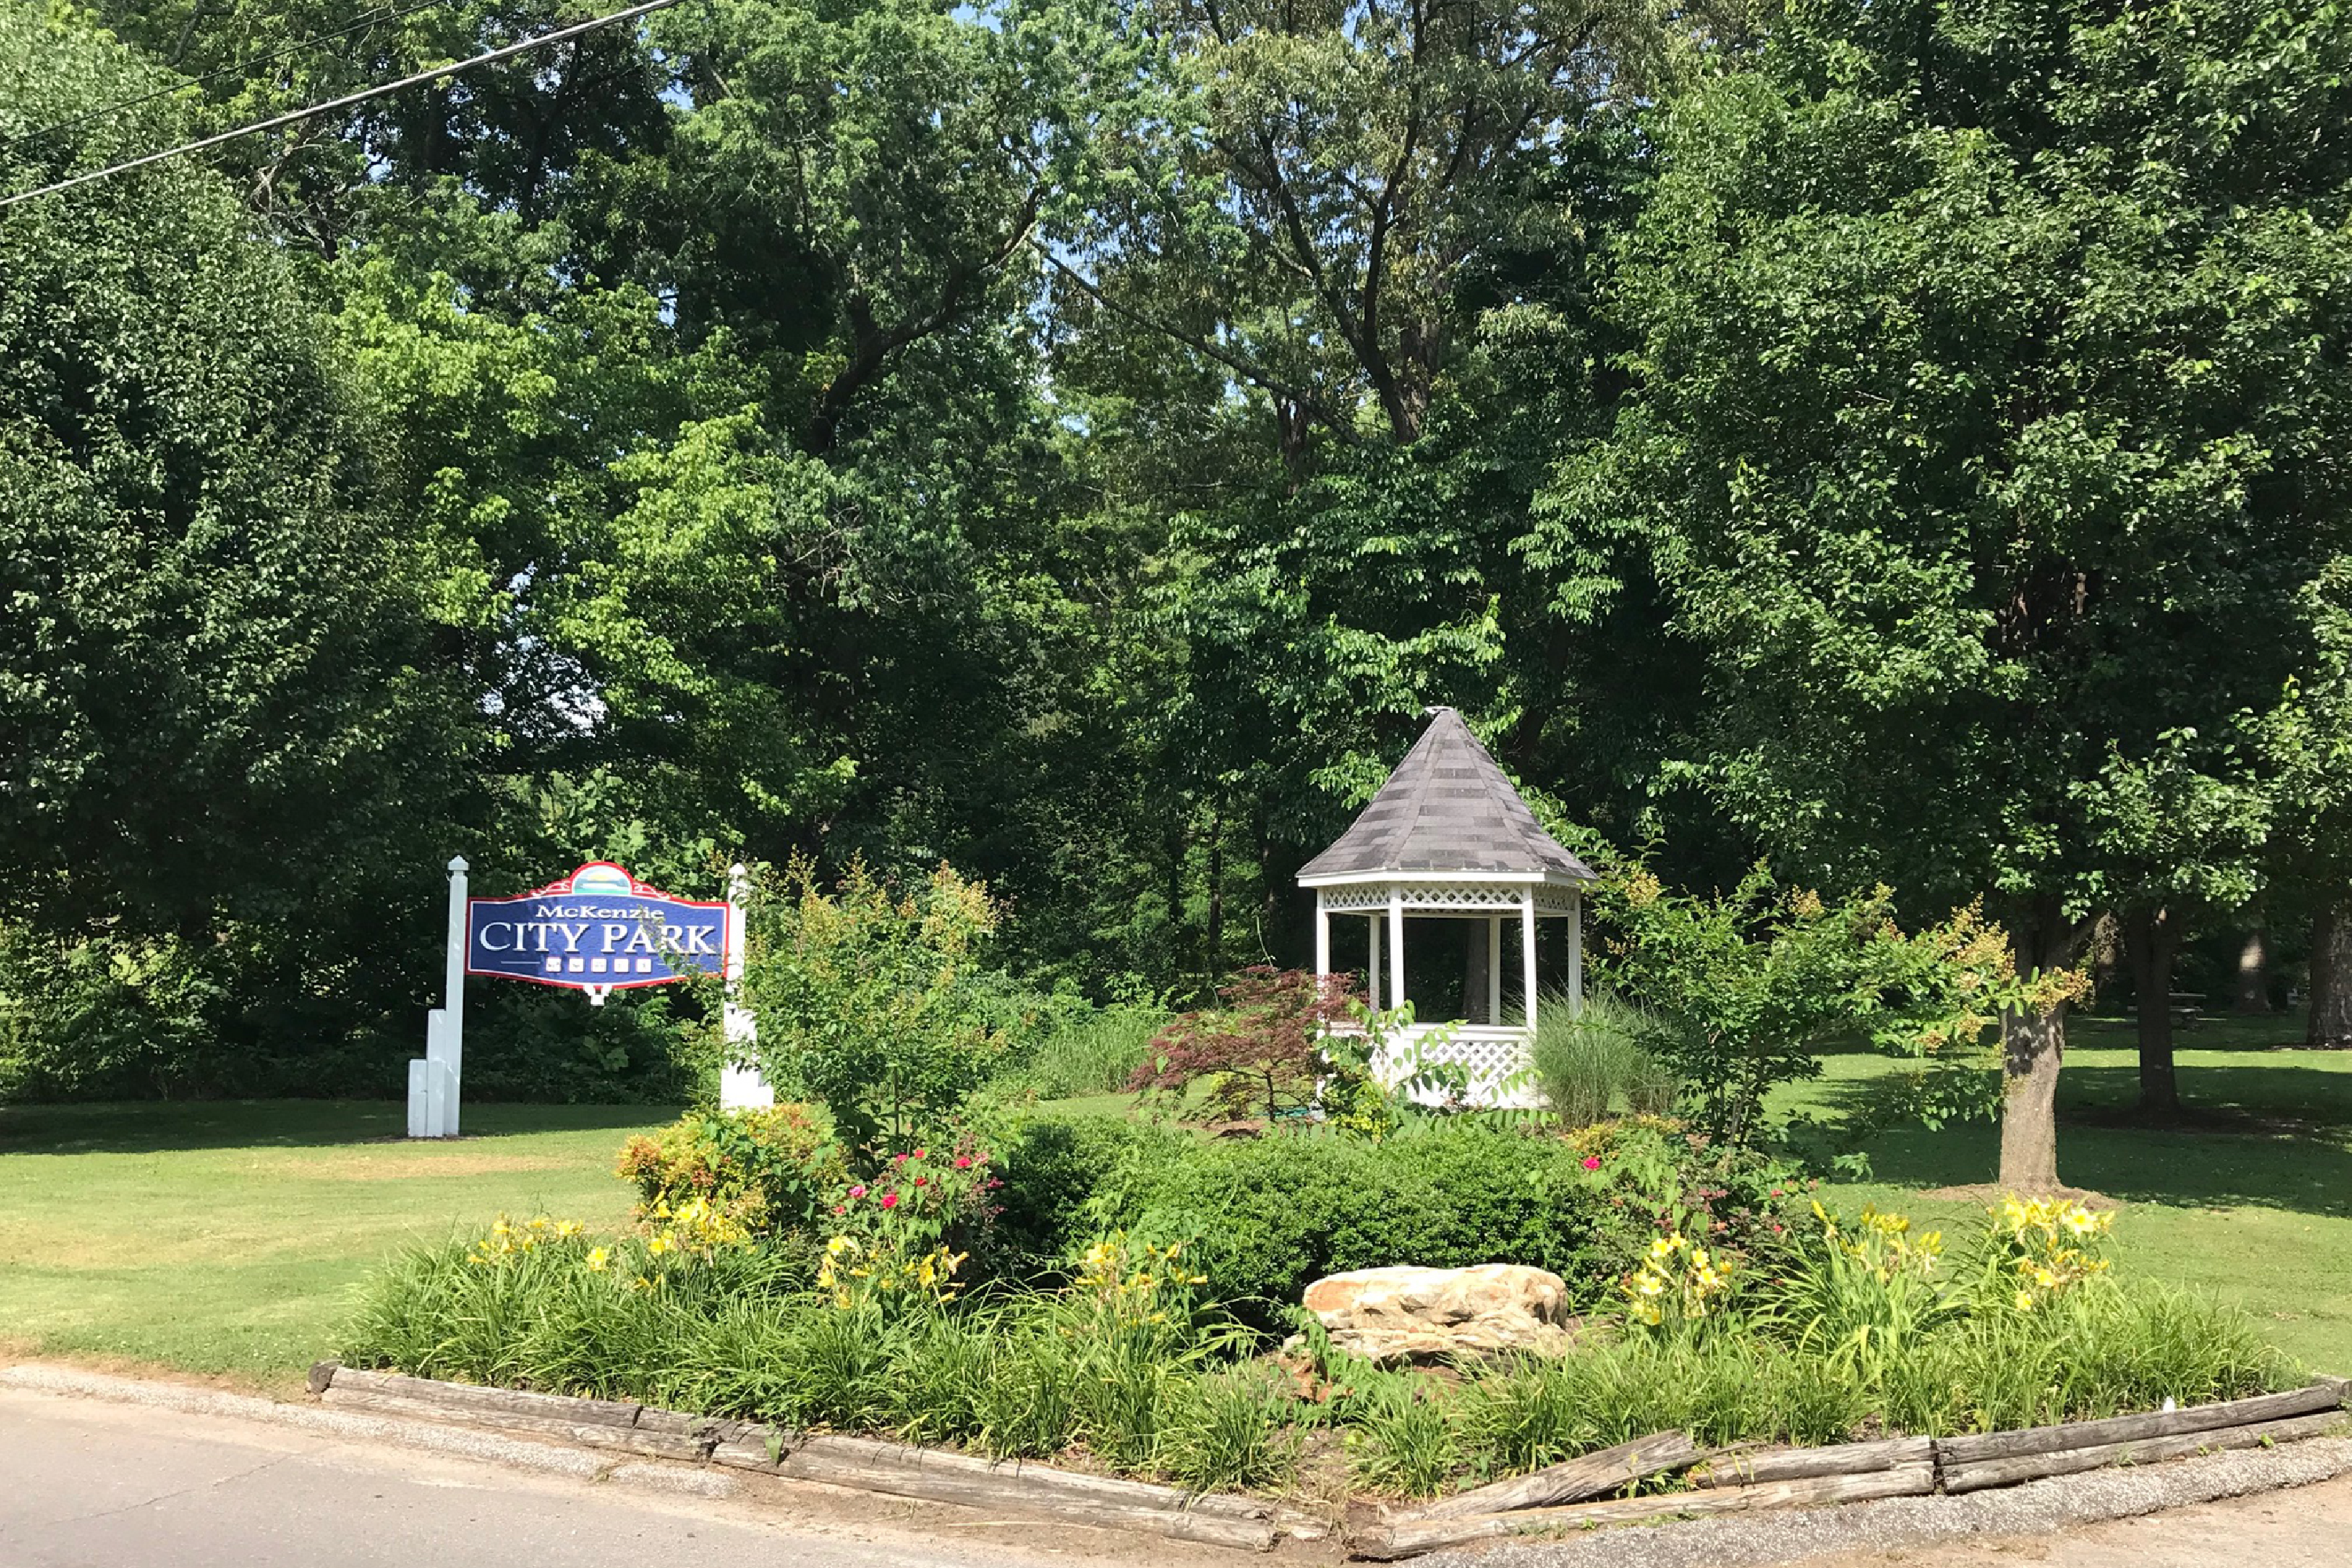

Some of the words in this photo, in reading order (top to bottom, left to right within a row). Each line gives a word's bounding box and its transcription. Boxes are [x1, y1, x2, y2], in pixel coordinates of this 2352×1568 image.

[535, 905, 665, 919] McKenzie
[479, 922, 589, 952] CITY
[601, 924, 717, 954] PARK
